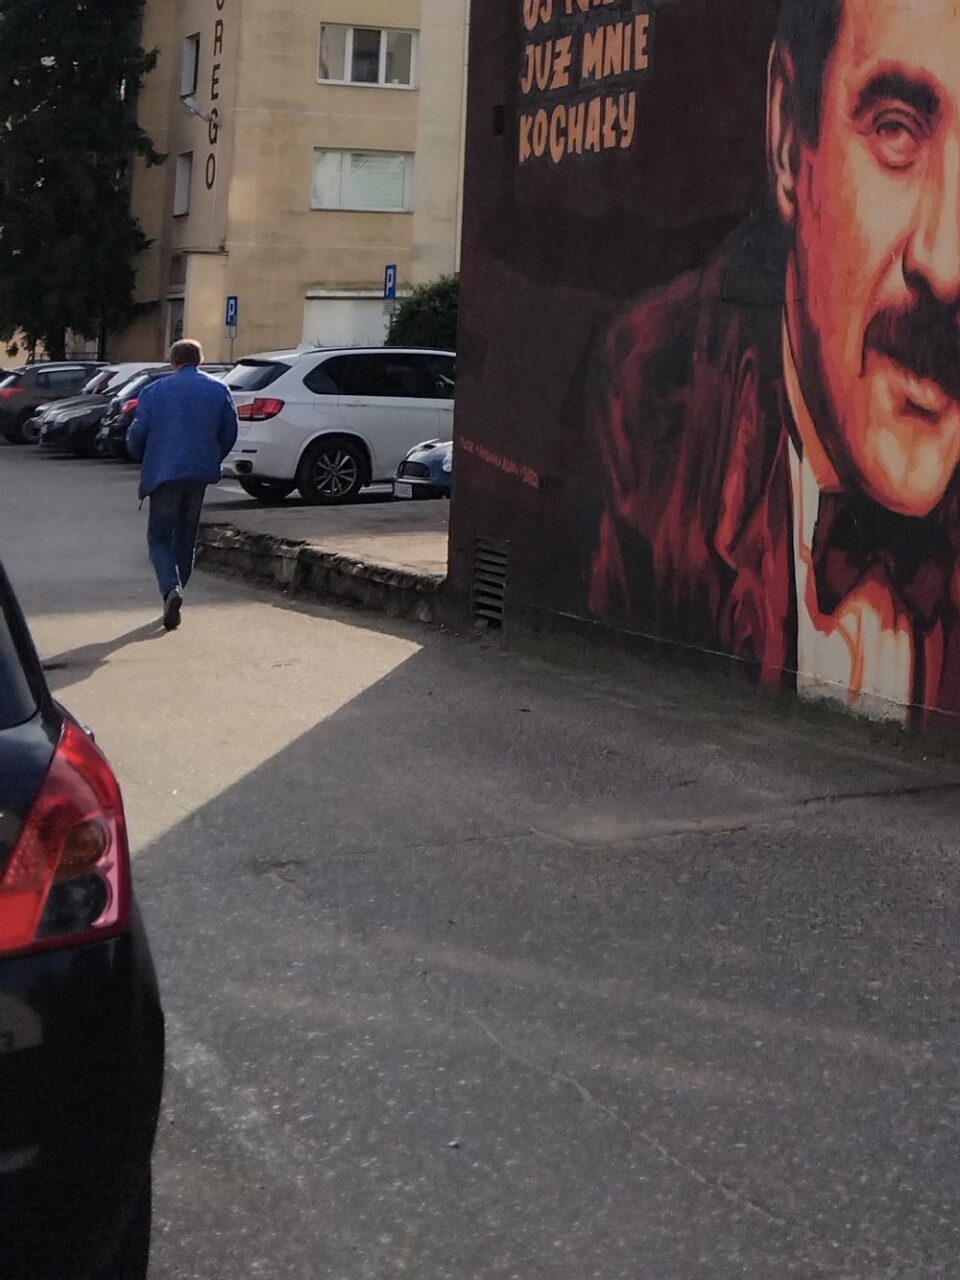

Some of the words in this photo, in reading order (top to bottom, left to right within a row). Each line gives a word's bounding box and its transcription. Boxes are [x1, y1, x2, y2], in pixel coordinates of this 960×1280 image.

[582, 14, 649, 81] MNIE
[519, 91, 636, 164] KOCHAŁY
[386, 268, 394, 296] P
[227, 299, 235, 322] P
